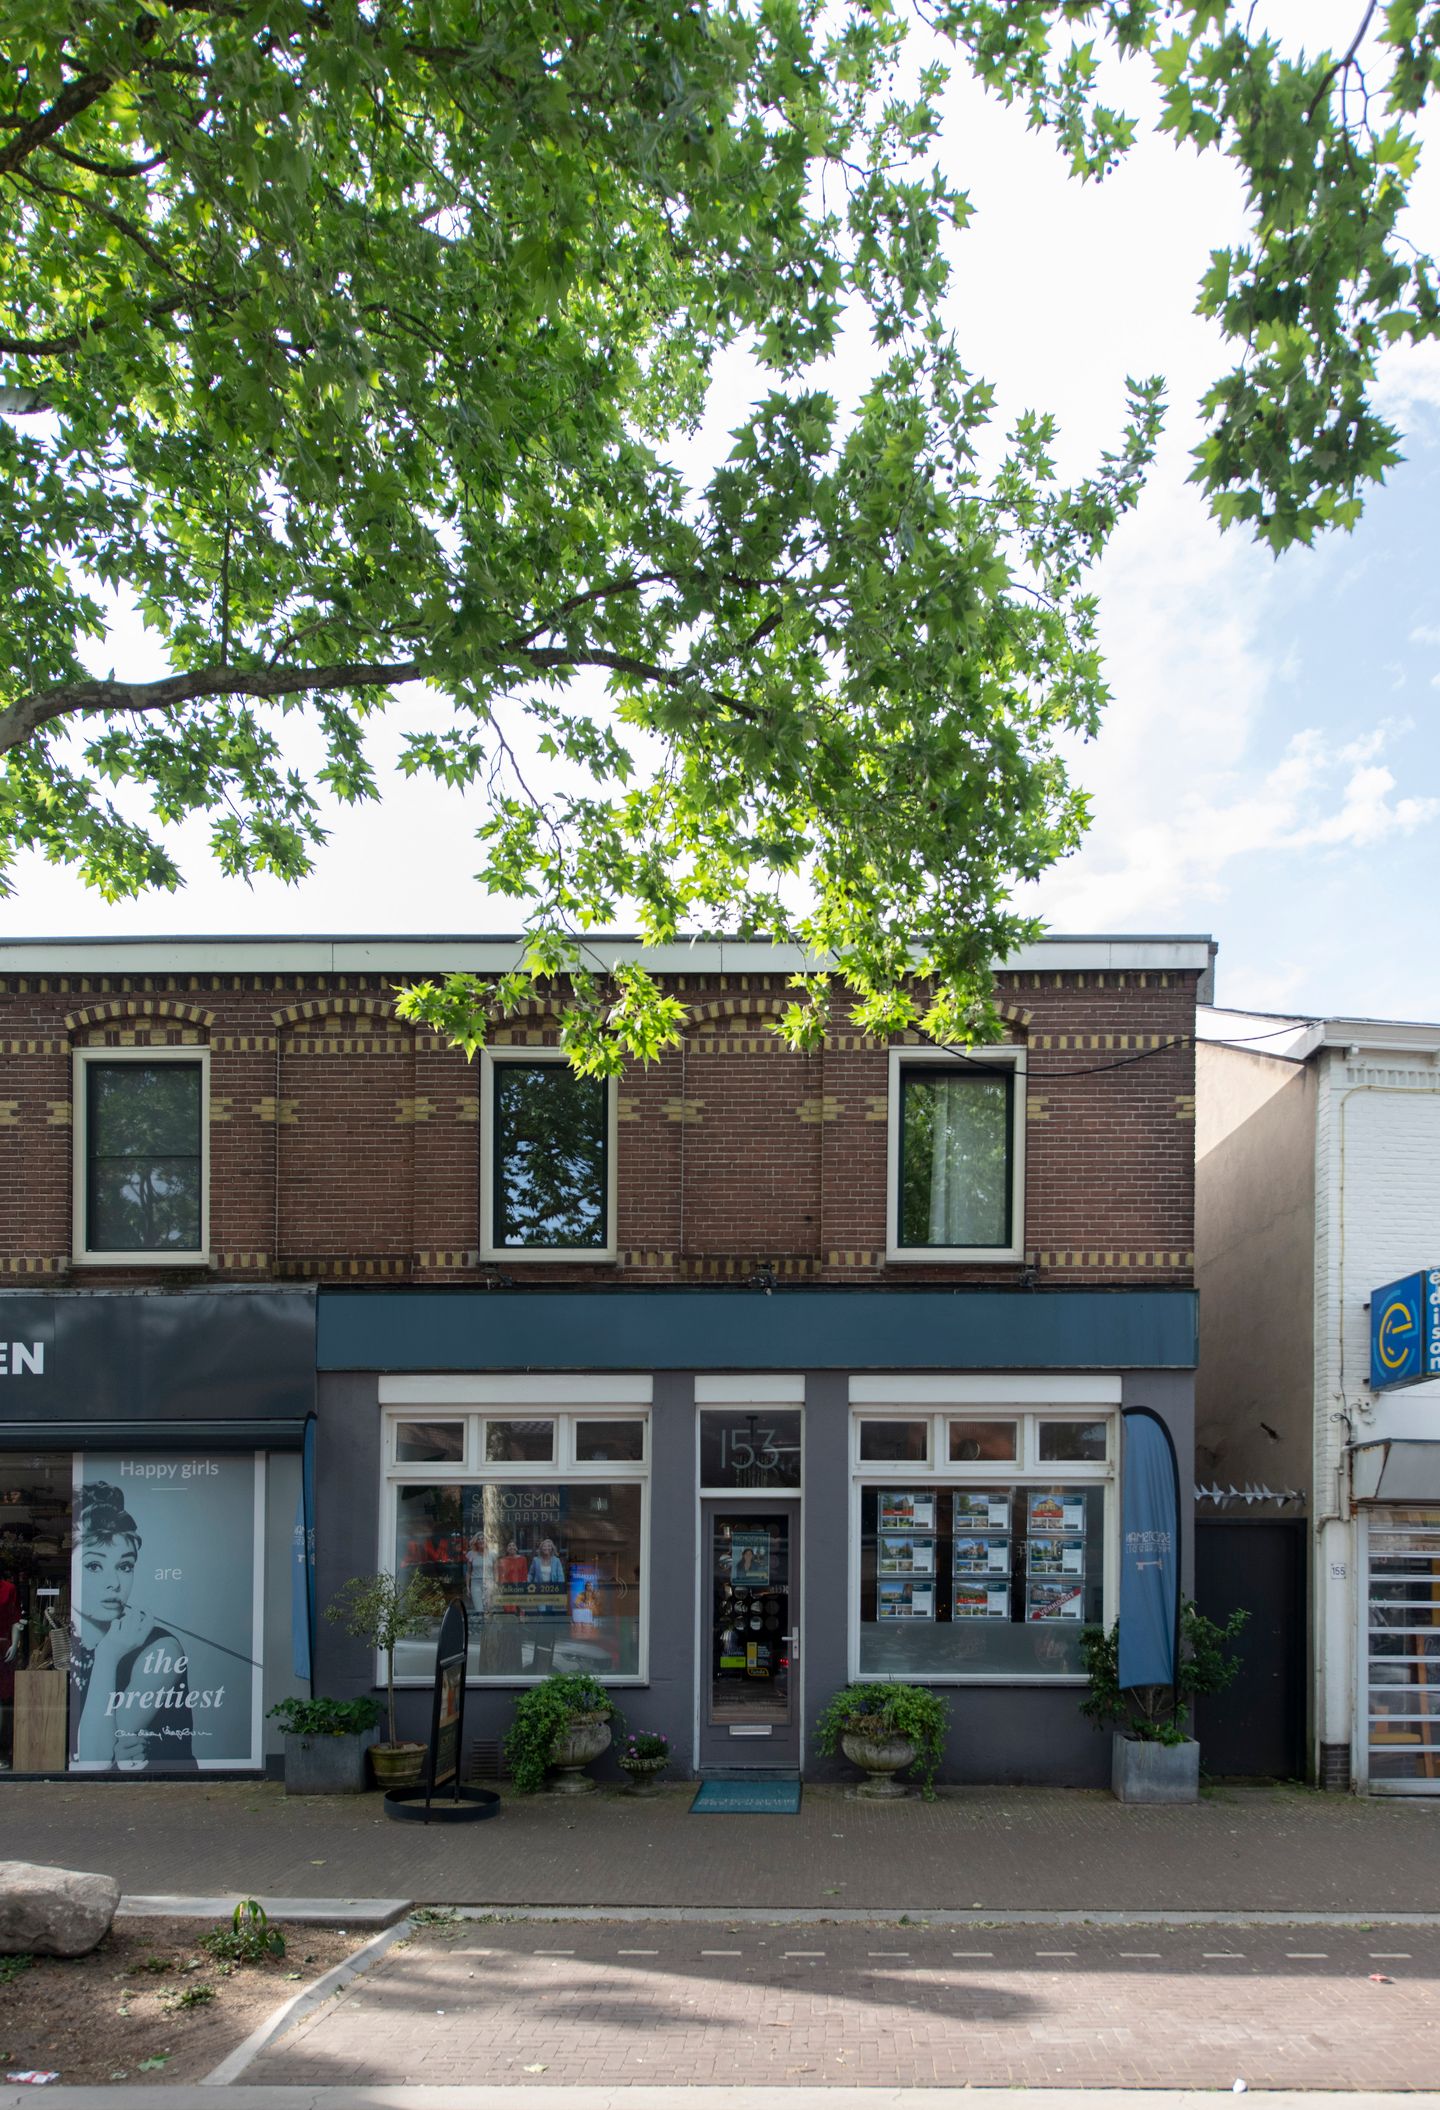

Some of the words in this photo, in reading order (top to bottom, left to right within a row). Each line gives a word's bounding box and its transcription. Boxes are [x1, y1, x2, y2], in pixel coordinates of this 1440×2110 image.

[721, 1429, 779, 1469] 153
[120, 1460, 178, 1479] Happy
[181, 1459, 219, 1479] girls
[471, 1492, 560, 1508] SOTSMAN
[471, 1511, 560, 1522] MELAARDIJ
[154, 1567, 183, 1581] are
[1332, 1566, 1345, 1575] 155
[143, 1648, 189, 1674] the
[104, 1683, 225, 1716] prettiest
